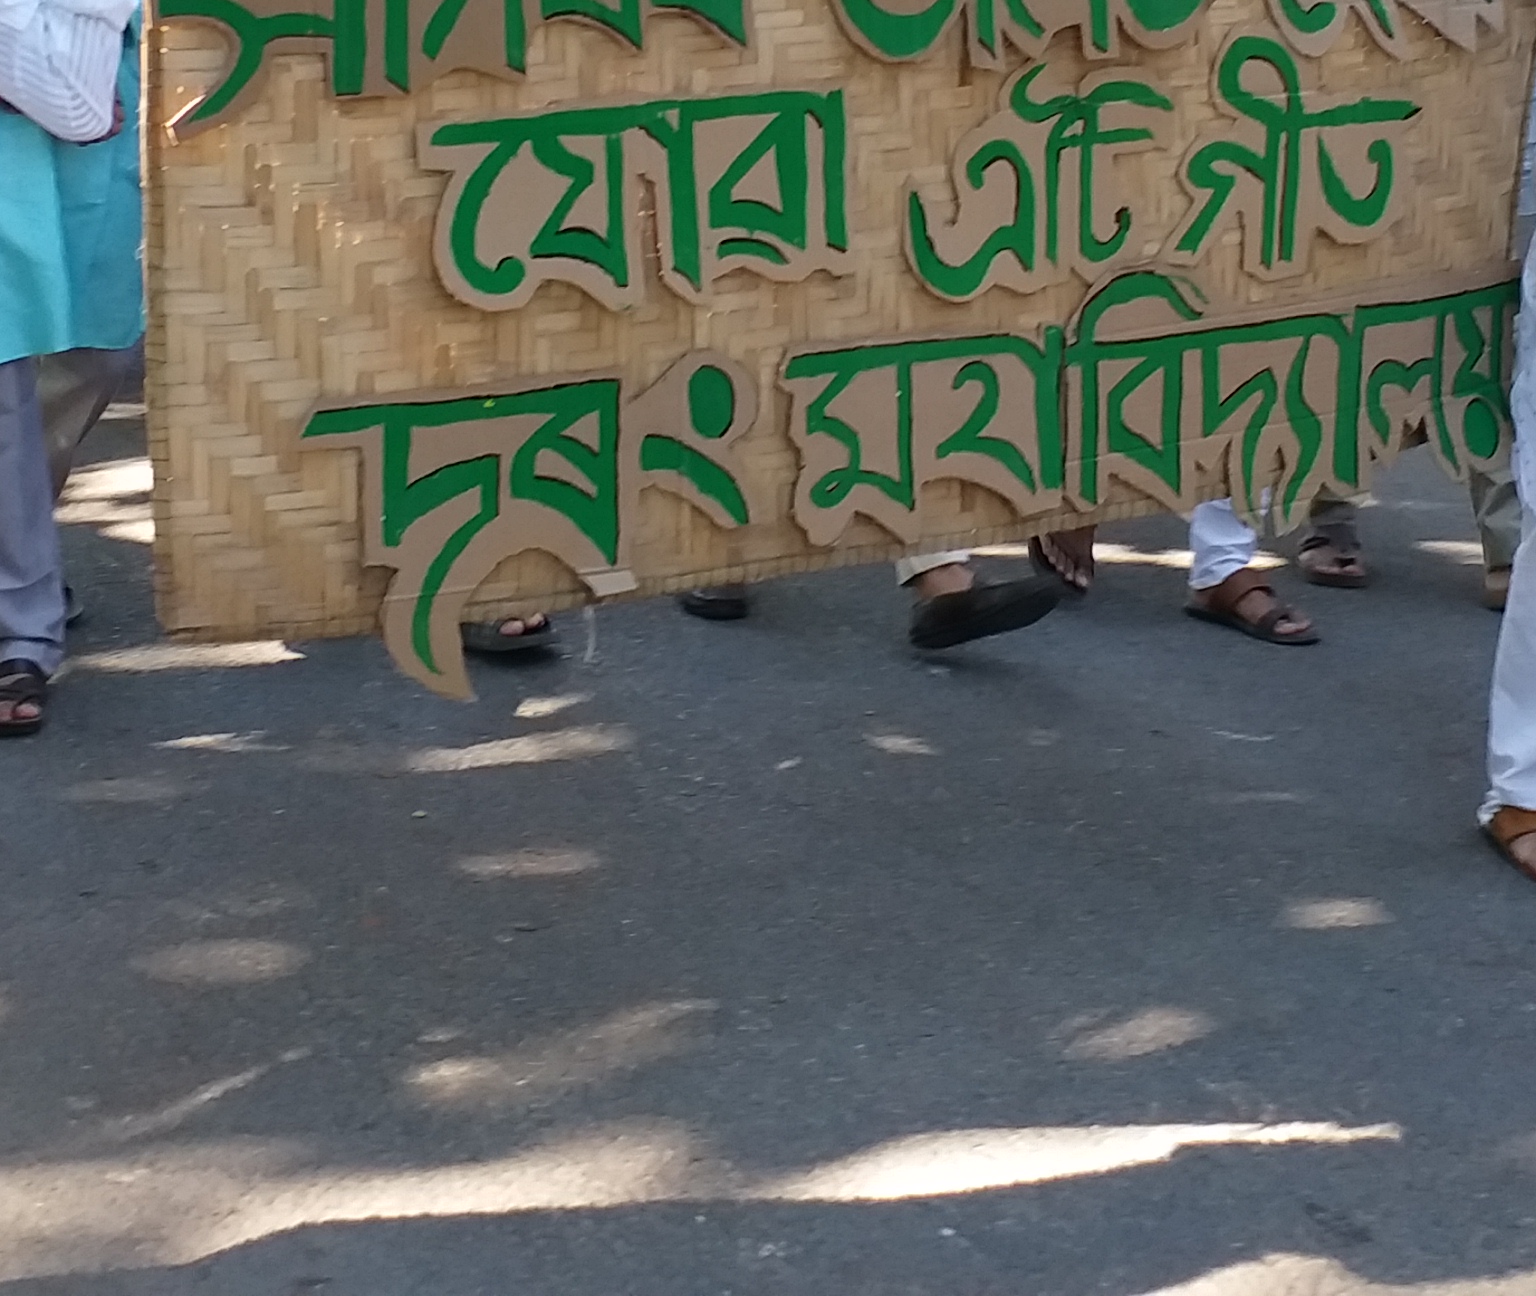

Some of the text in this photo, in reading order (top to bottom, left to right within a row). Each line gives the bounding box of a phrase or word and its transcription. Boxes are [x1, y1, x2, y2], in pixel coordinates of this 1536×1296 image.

[431, 35, 1422, 296] যোৱা এটি গীত
